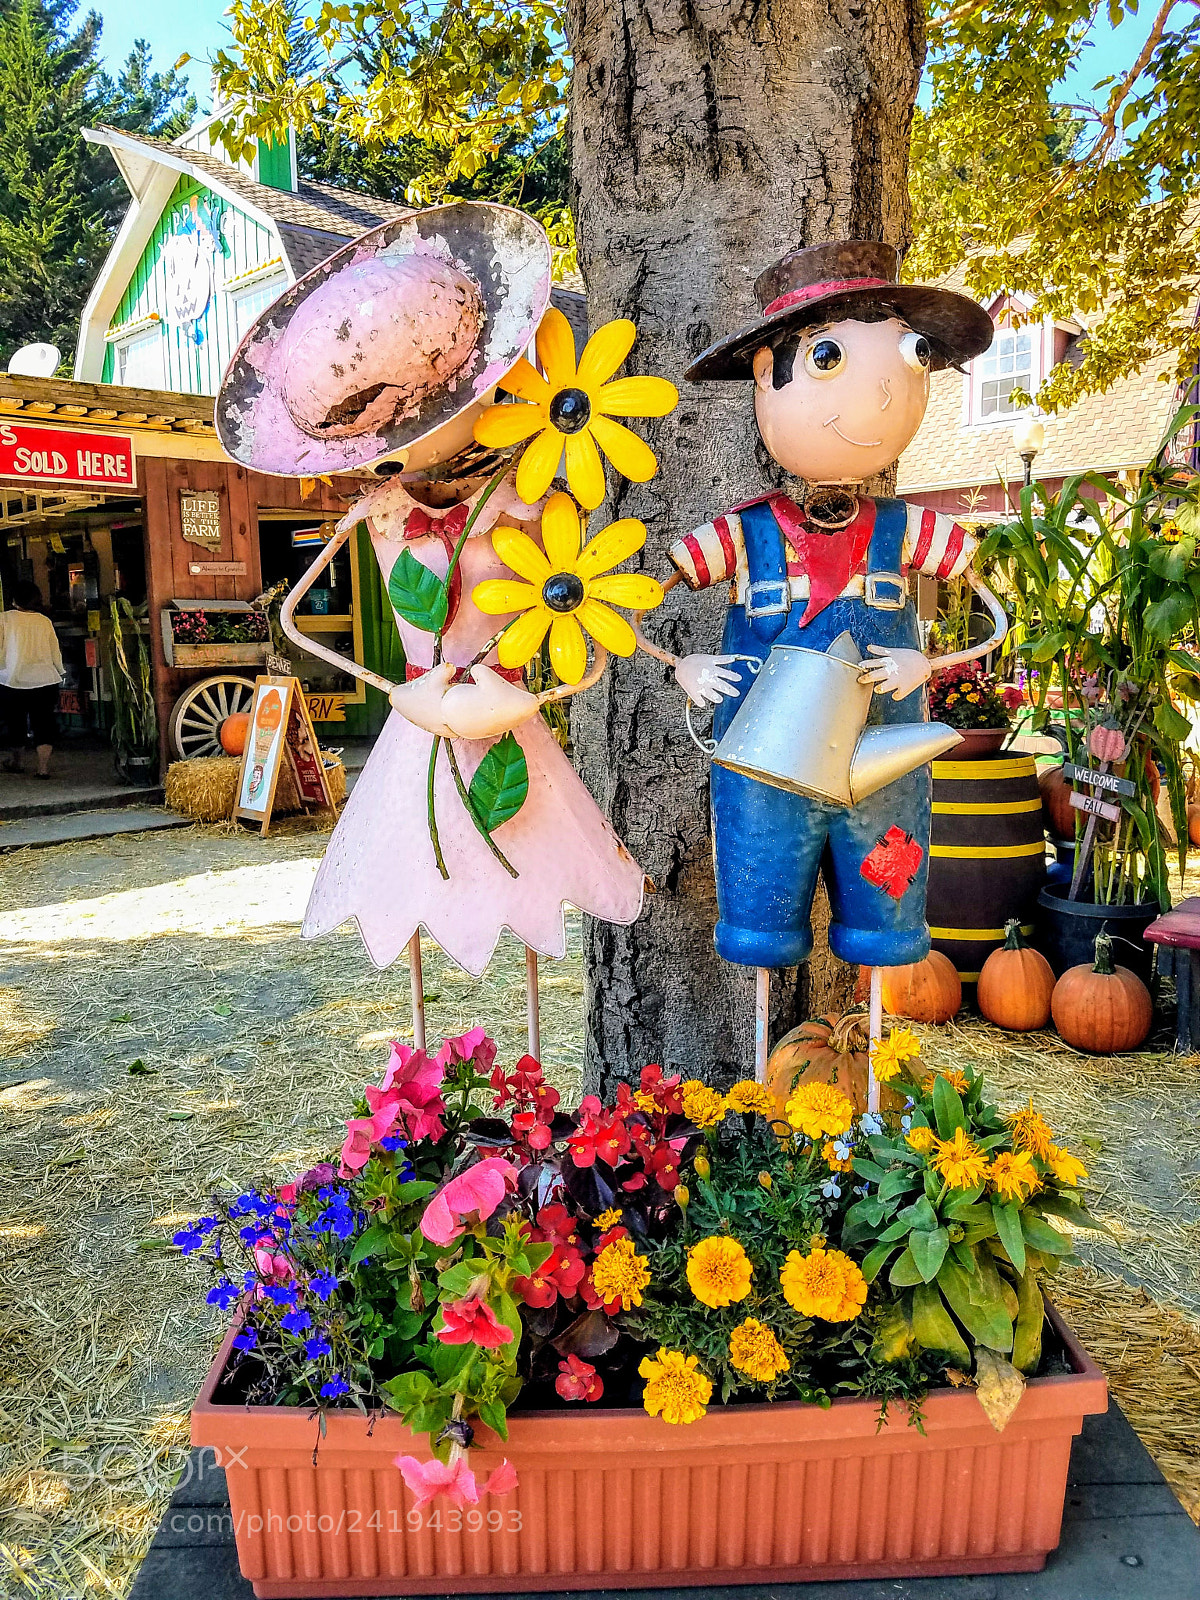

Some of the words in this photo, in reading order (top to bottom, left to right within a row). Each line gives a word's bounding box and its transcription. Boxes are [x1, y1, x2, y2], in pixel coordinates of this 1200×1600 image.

[13, 447, 68, 475] SOLD
[76, 449, 128, 478] HERE
[182, 499, 219, 513] LIFE
[183, 517, 196, 525] ON
[200, 518, 219, 526] THE
[191, 512, 219, 520] BETTER
[183, 524, 220, 538] FARM
[305, 696, 334, 719] RN
[1073, 766, 1120, 793] WELCOME
[1083, 798, 1104, 816] FALL
